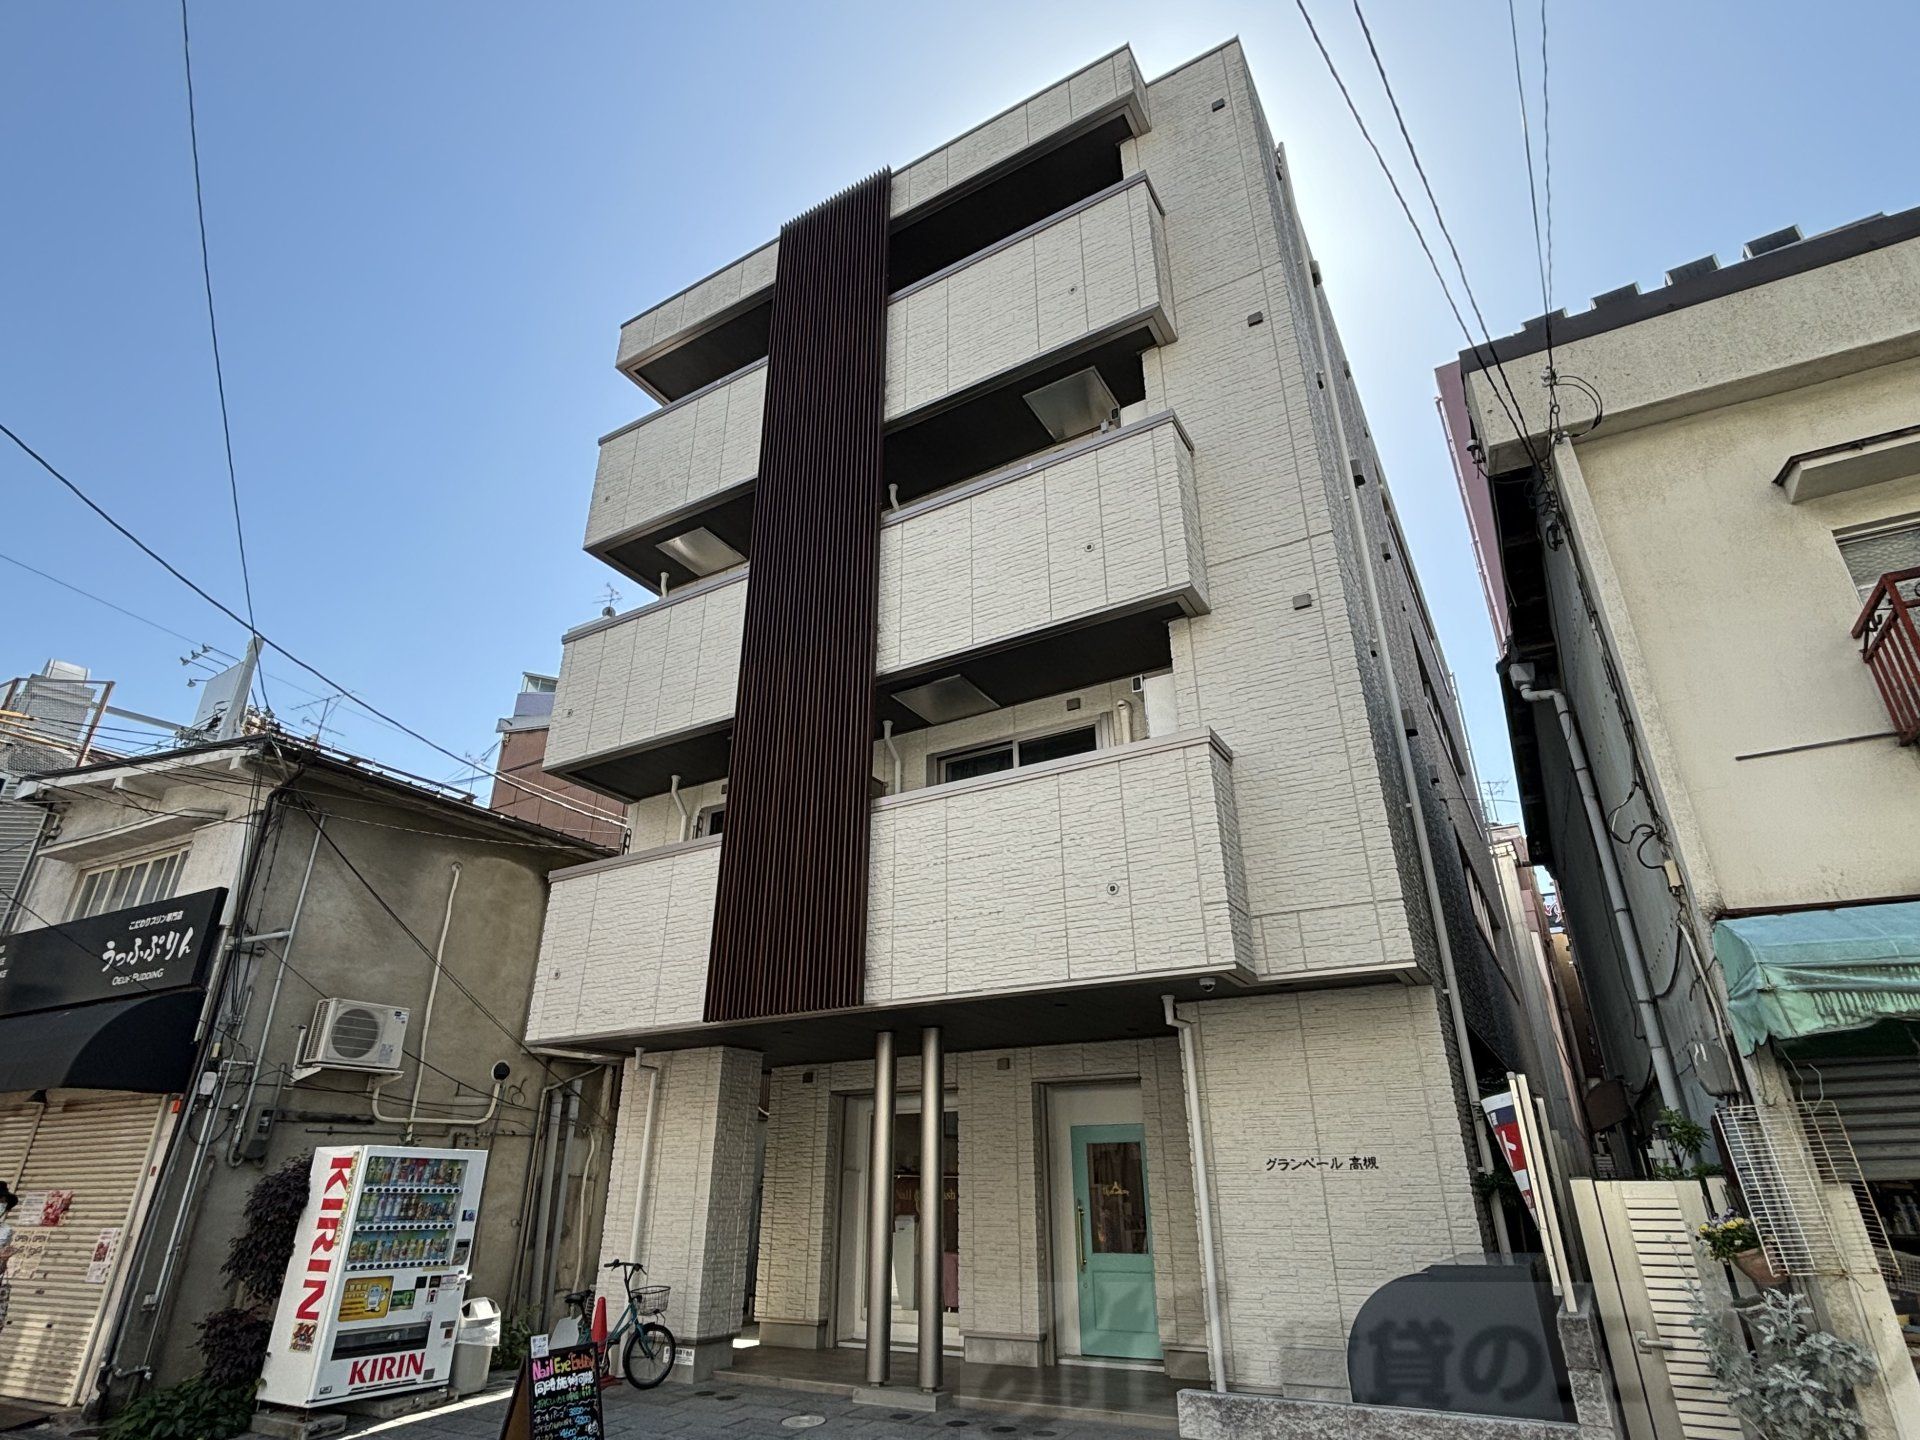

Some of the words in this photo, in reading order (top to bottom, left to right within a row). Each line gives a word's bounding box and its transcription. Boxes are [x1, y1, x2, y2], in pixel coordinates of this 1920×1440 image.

[1349, 1155, 1379, 1171] 高槻
[296, 1157, 353, 1321] KIRIN
[348, 1352, 425, 1386] KIRIN
[532, 1358, 554, 1381] Nail
[554, 1356, 572, 1374] Eye
